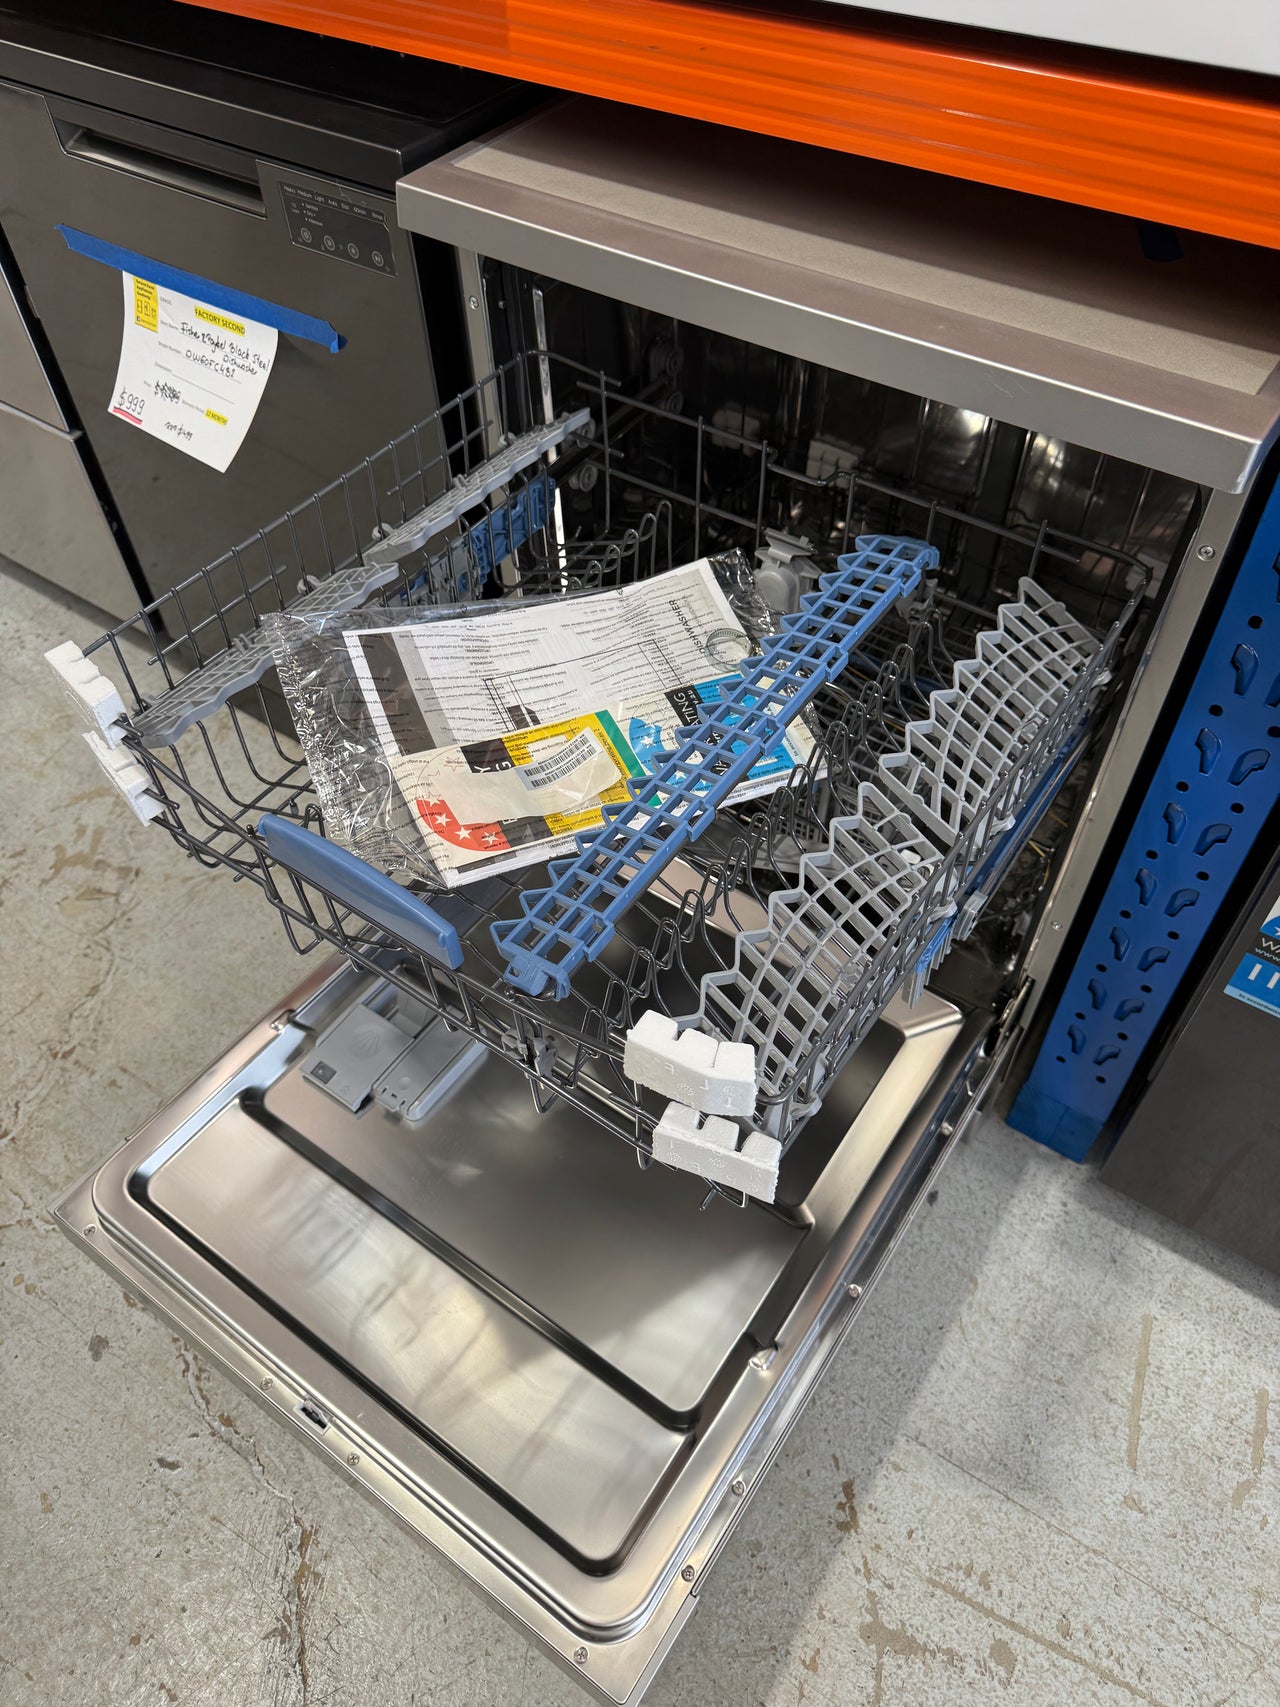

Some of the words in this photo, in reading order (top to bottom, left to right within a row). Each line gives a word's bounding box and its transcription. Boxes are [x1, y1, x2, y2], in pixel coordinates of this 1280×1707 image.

[195, 308, 220, 324] FACTORY
[222, 319, 245, 334] SECOND
[229, 342, 250, 360] Black
[252, 353, 270, 372] Steel
[118, 386, 145, 416] $999
